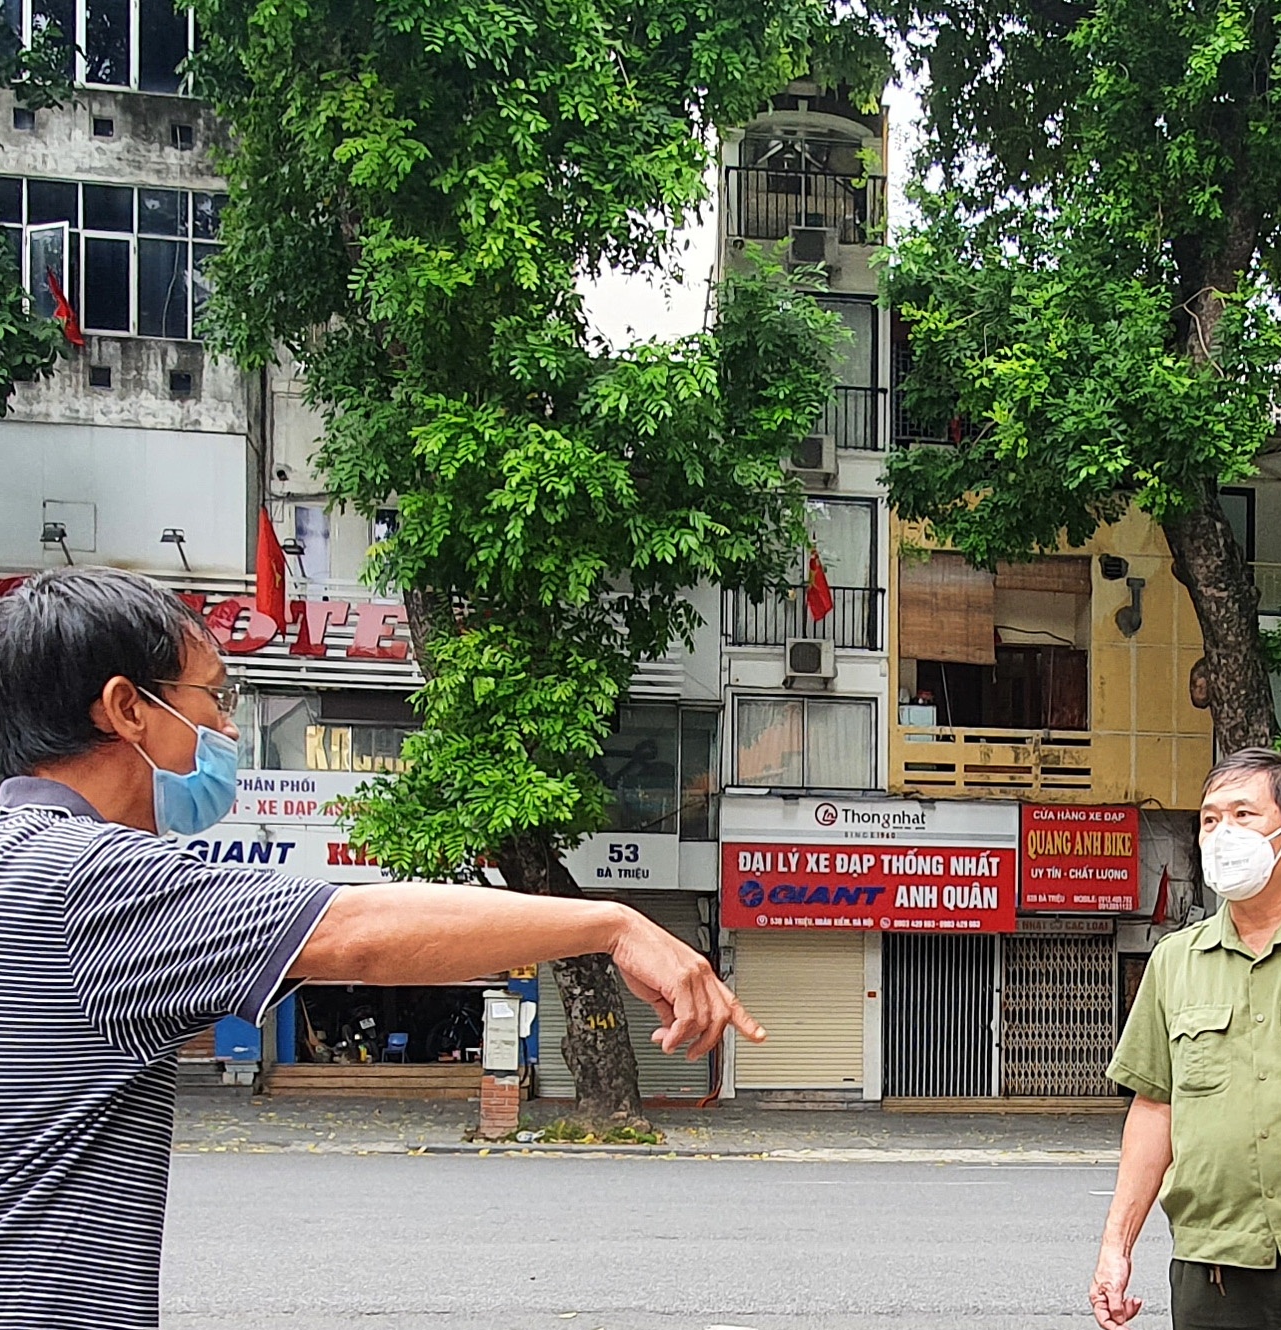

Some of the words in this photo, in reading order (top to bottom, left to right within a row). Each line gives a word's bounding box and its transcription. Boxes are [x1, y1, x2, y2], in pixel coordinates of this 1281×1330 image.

[280, 775, 316, 793] PHỐI
[256, 799, 278, 816] XE
[283, 799, 318, 820] ĐẠP
[1033, 807, 1055, 820] CỬA
[1057, 809, 1087, 820] HÀNG
[1088, 811, 1102, 821] XE
[1104, 811, 1126, 824] ĐẠP
[608, 843, 639, 863] 53
[1027, 829, 1072, 860] QUANG
[1074, 830, 1102, 856] ANH
[1103, 831, 1133, 857] BIKE
[738, 851, 772, 877] ĐẠI
[777, 847, 800, 873] LÝ
[805, 852, 831, 874] XE
[835, 853, 876, 878] ĐẠP
[880, 847, 944, 876] THỐNG
[950, 850, 1000, 877] NHẤT
[596, 866, 613, 879] BÀ
[617, 867, 650, 880] TRIỆU
[1030, 868, 1045, 879] UY
[1046, 865, 1062, 879] TÍN
[1069, 864, 1094, 880] CHẤT
[1096, 868, 1128, 882] LƯỢNG
[768, 884, 886, 906] GIANT
[894, 885, 938, 909] ANH
[942, 881, 998, 911] QUÂN
[586, 1011, 616, 1030] 141
